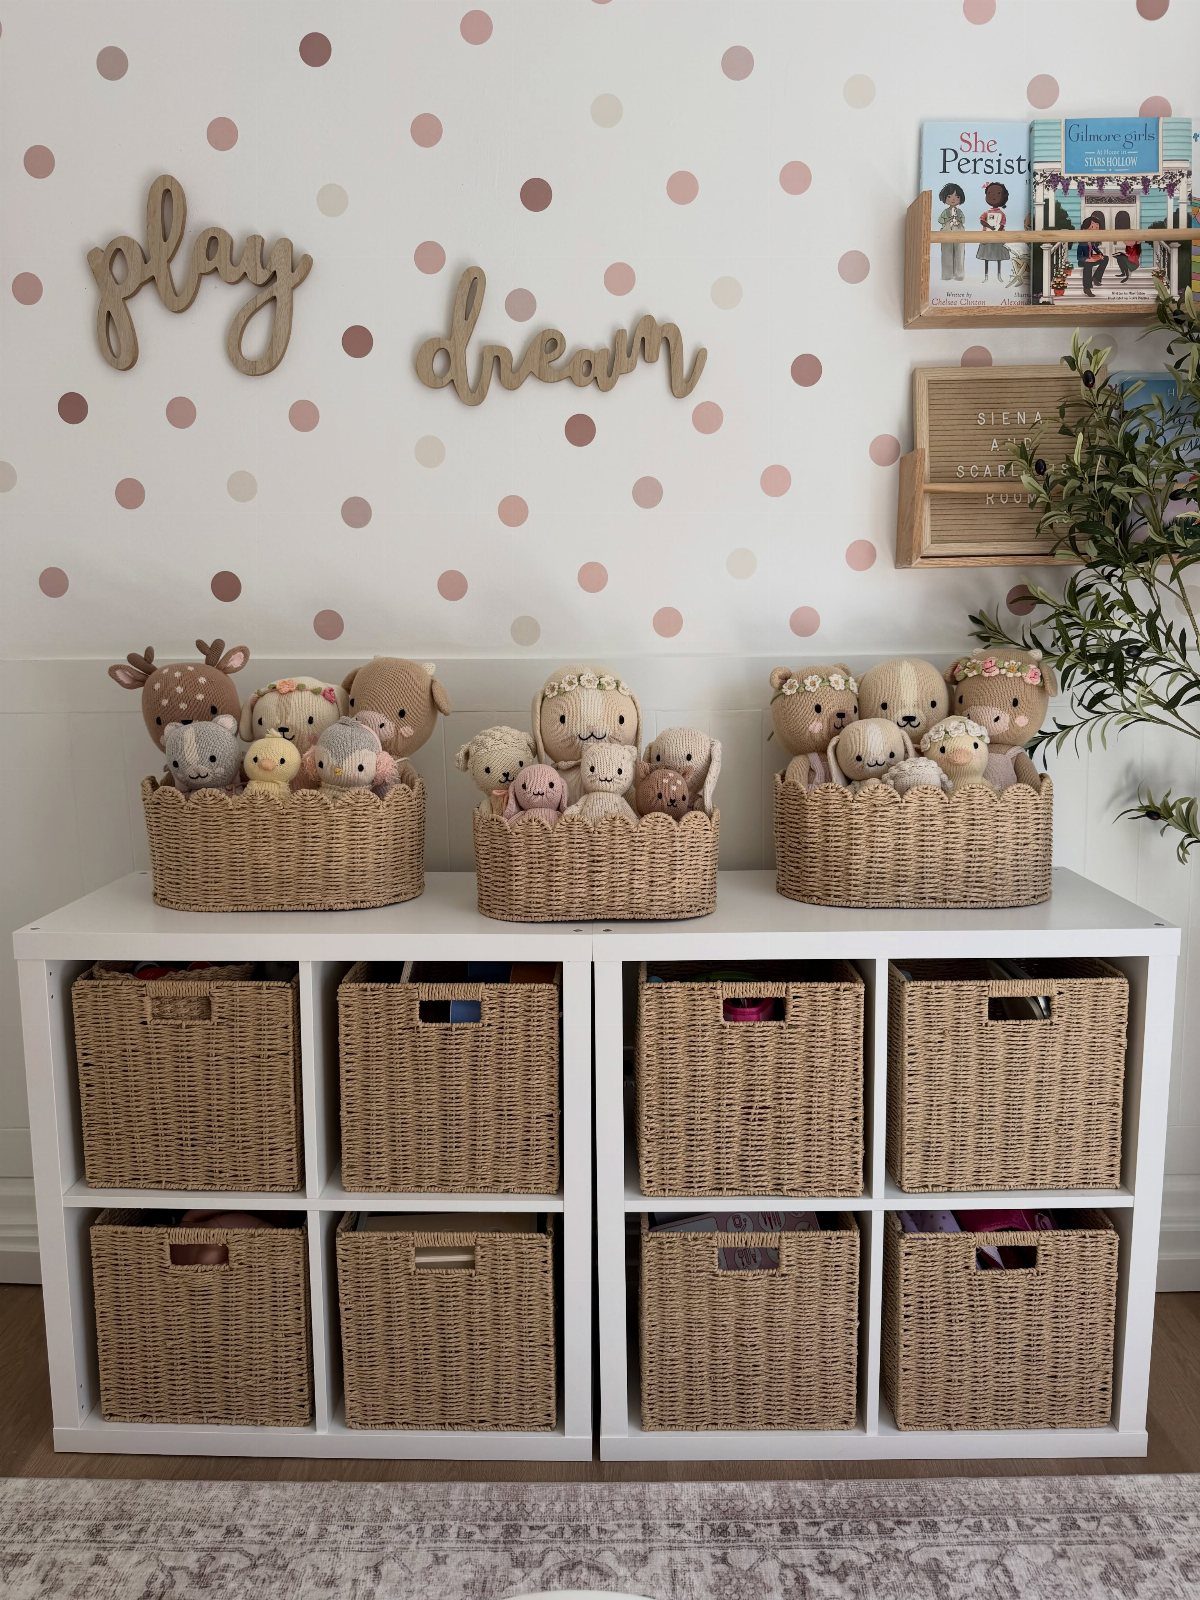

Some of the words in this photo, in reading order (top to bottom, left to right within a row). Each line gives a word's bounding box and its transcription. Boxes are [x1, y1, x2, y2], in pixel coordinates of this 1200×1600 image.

[960, 131, 998, 153] She
[1068, 123, 1121, 142] Gilmore
[1122, 122, 1155, 150] girls
[939, 147, 1031, 175] Persist
[1084, 157, 1106, 168] STARS
[1106, 156, 1138, 168] HOLLOW
[87, 174, 313, 376] play
[931, 298, 958, 306] Chelsea
[959, 298, 986, 306] Clinton
[415, 266, 708, 406] dream
[977, 411, 1043, 426] SIENA
[990, 437, 1032, 452] AD
